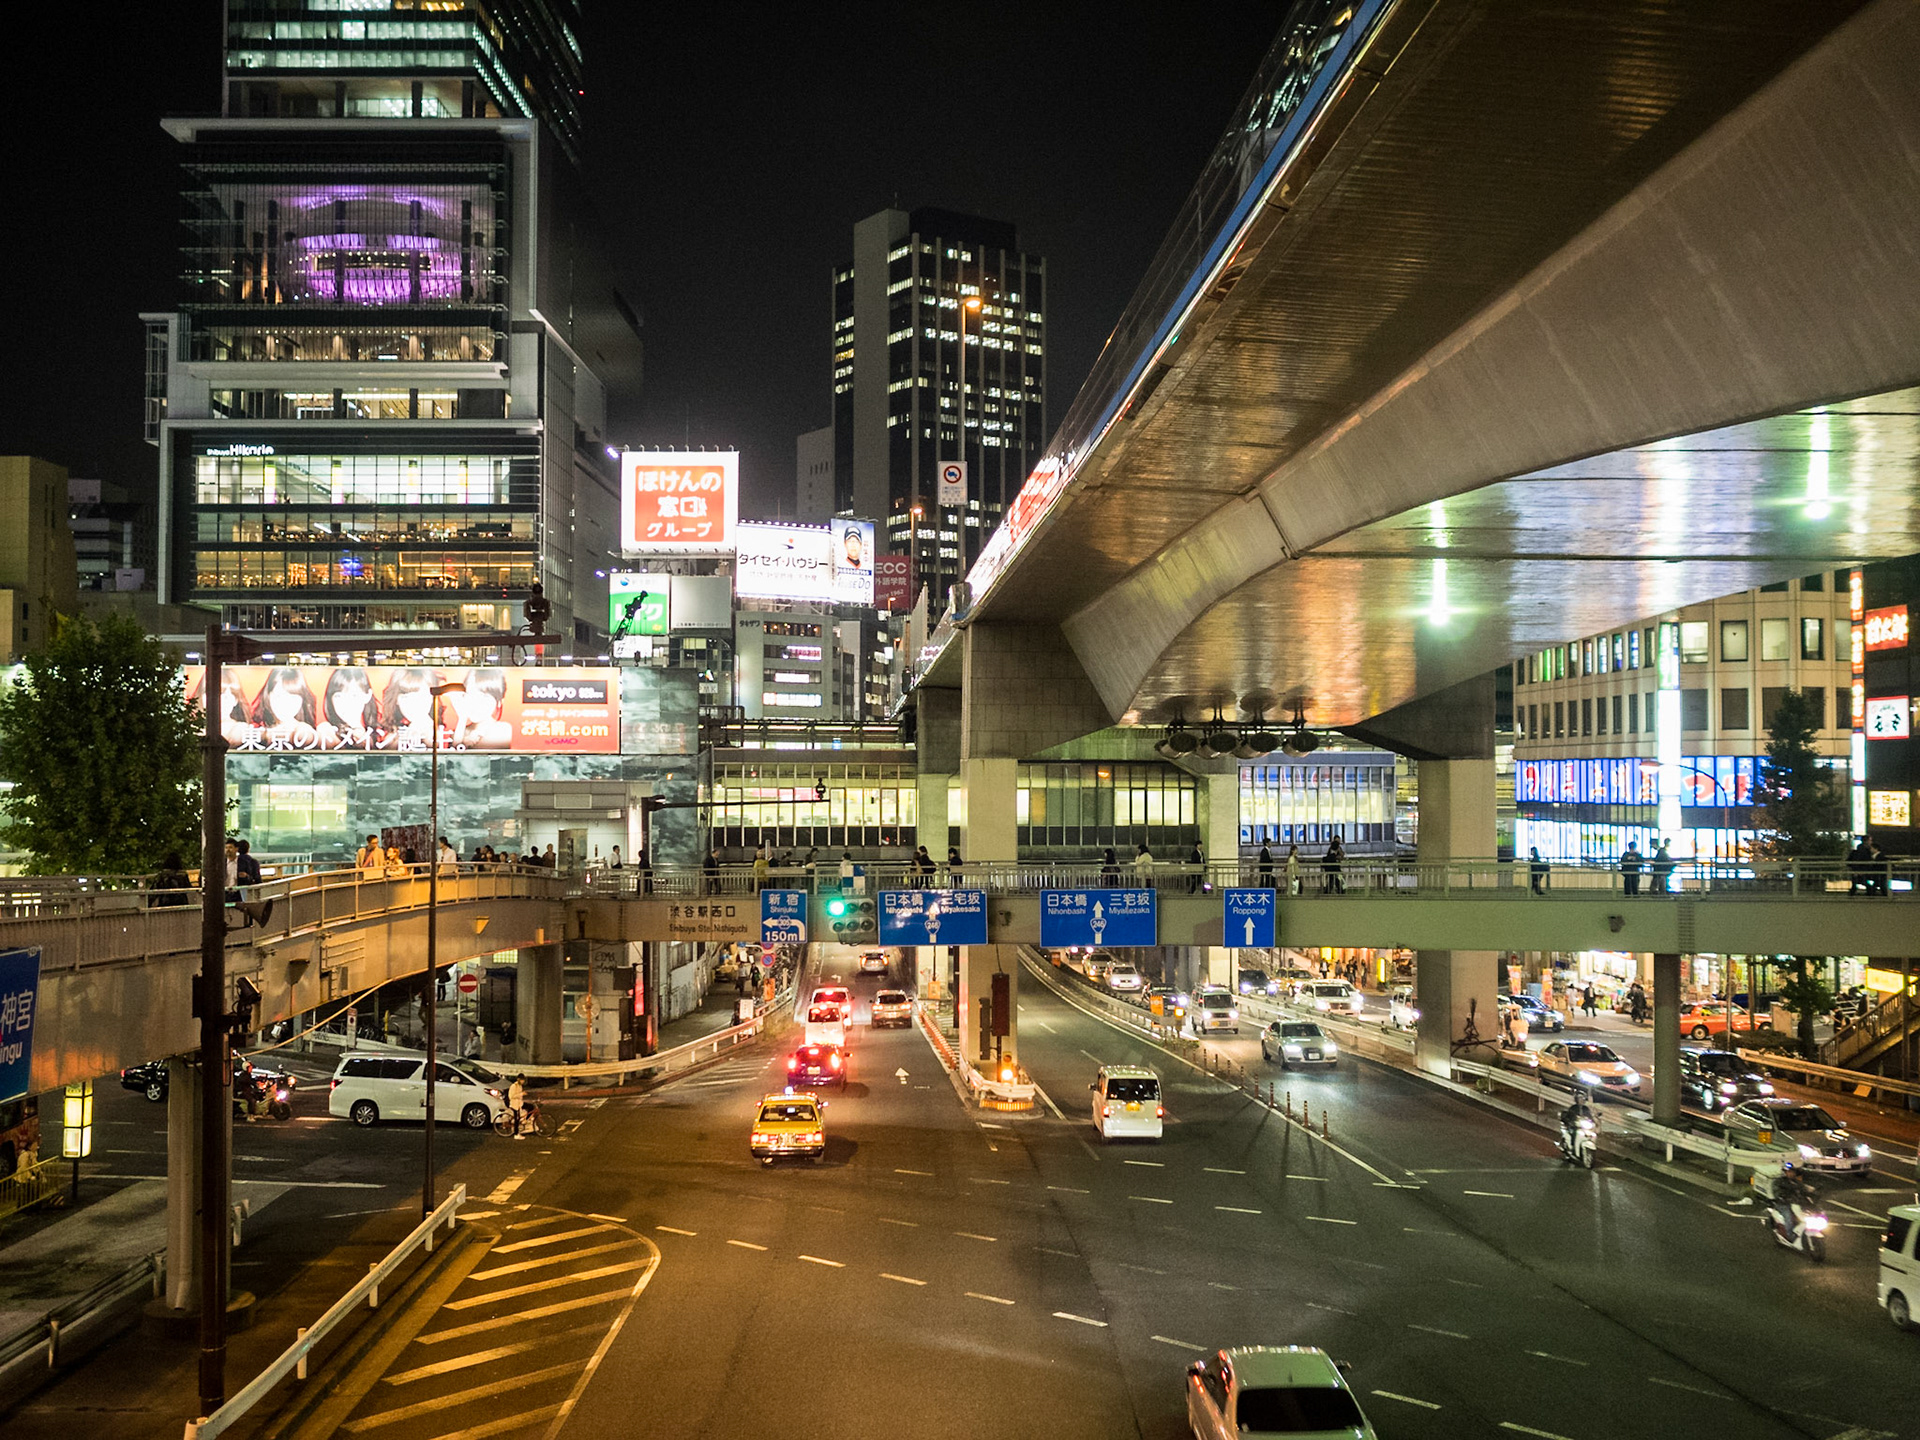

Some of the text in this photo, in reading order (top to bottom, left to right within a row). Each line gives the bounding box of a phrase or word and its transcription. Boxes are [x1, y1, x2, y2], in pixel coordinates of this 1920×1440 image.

[230, 444, 275, 456] Hikarie
[638, 470, 722, 492] ほけんの
[647, 521, 713, 538] グループ
[875, 562, 907, 575] ECC
[526, 683, 577, 701] .tokyo
[521, 719, 609, 736] お名前.com
[236, 724, 466, 751] 東京のドメイン誕生。
[551, 737, 579, 745] GMO
[768, 893, 799, 906] 新宿
[885, 892, 981, 907] 日本橋 三宅坂
[1046, 892, 1150, 907] 日本橋 三宅坂
[1228, 892, 1271, 906] 六本木
[670, 905, 736, 918] 渋谷駅西口
[770, 906, 798, 914] Shinjuku
[1108, 907, 1151, 915] Miyakezaka
[1232, 906, 1267, 916] Roppongi
[669, 923, 696, 935] Shibuya
[1092, 920, 1105, 929] 246
[765, 931, 798, 942] 150m
